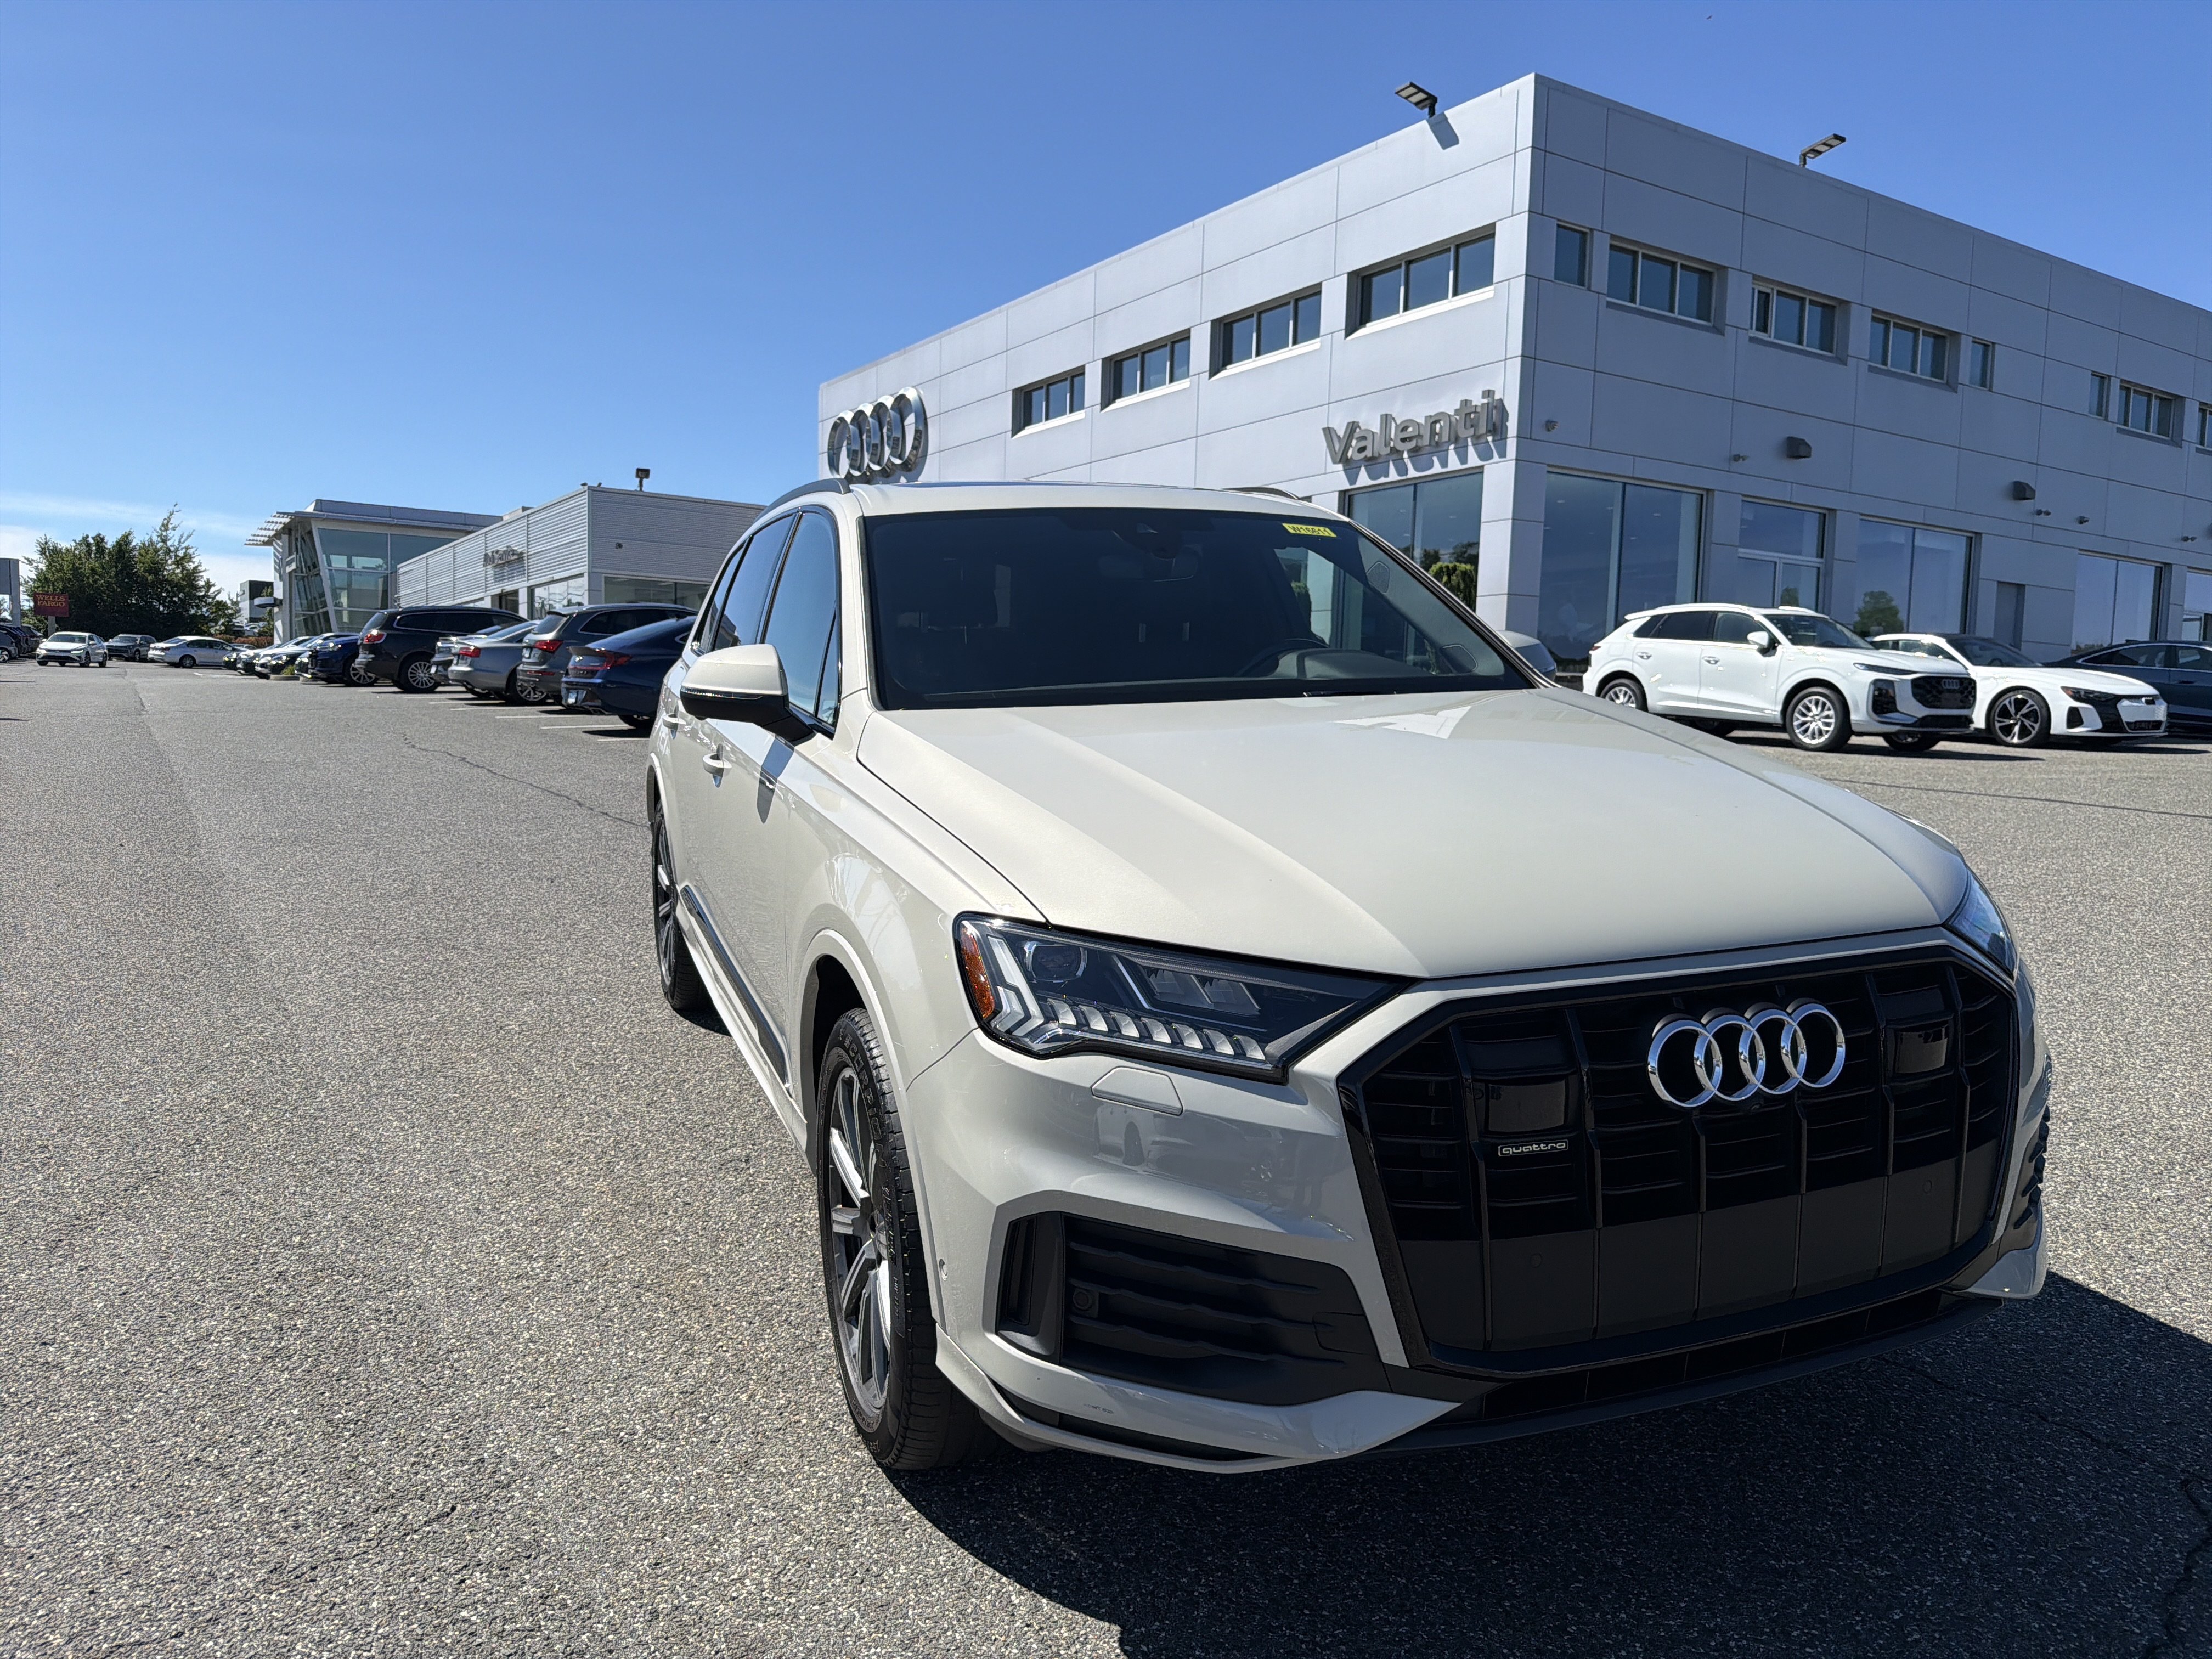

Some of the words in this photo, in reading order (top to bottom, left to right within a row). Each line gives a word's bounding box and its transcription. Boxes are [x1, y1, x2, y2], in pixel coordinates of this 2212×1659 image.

[1322, 389, 1495, 465] Valenti
[844, 1034, 888, 1169] SCORPION
[1502, 1142, 1566, 1154] quattro
